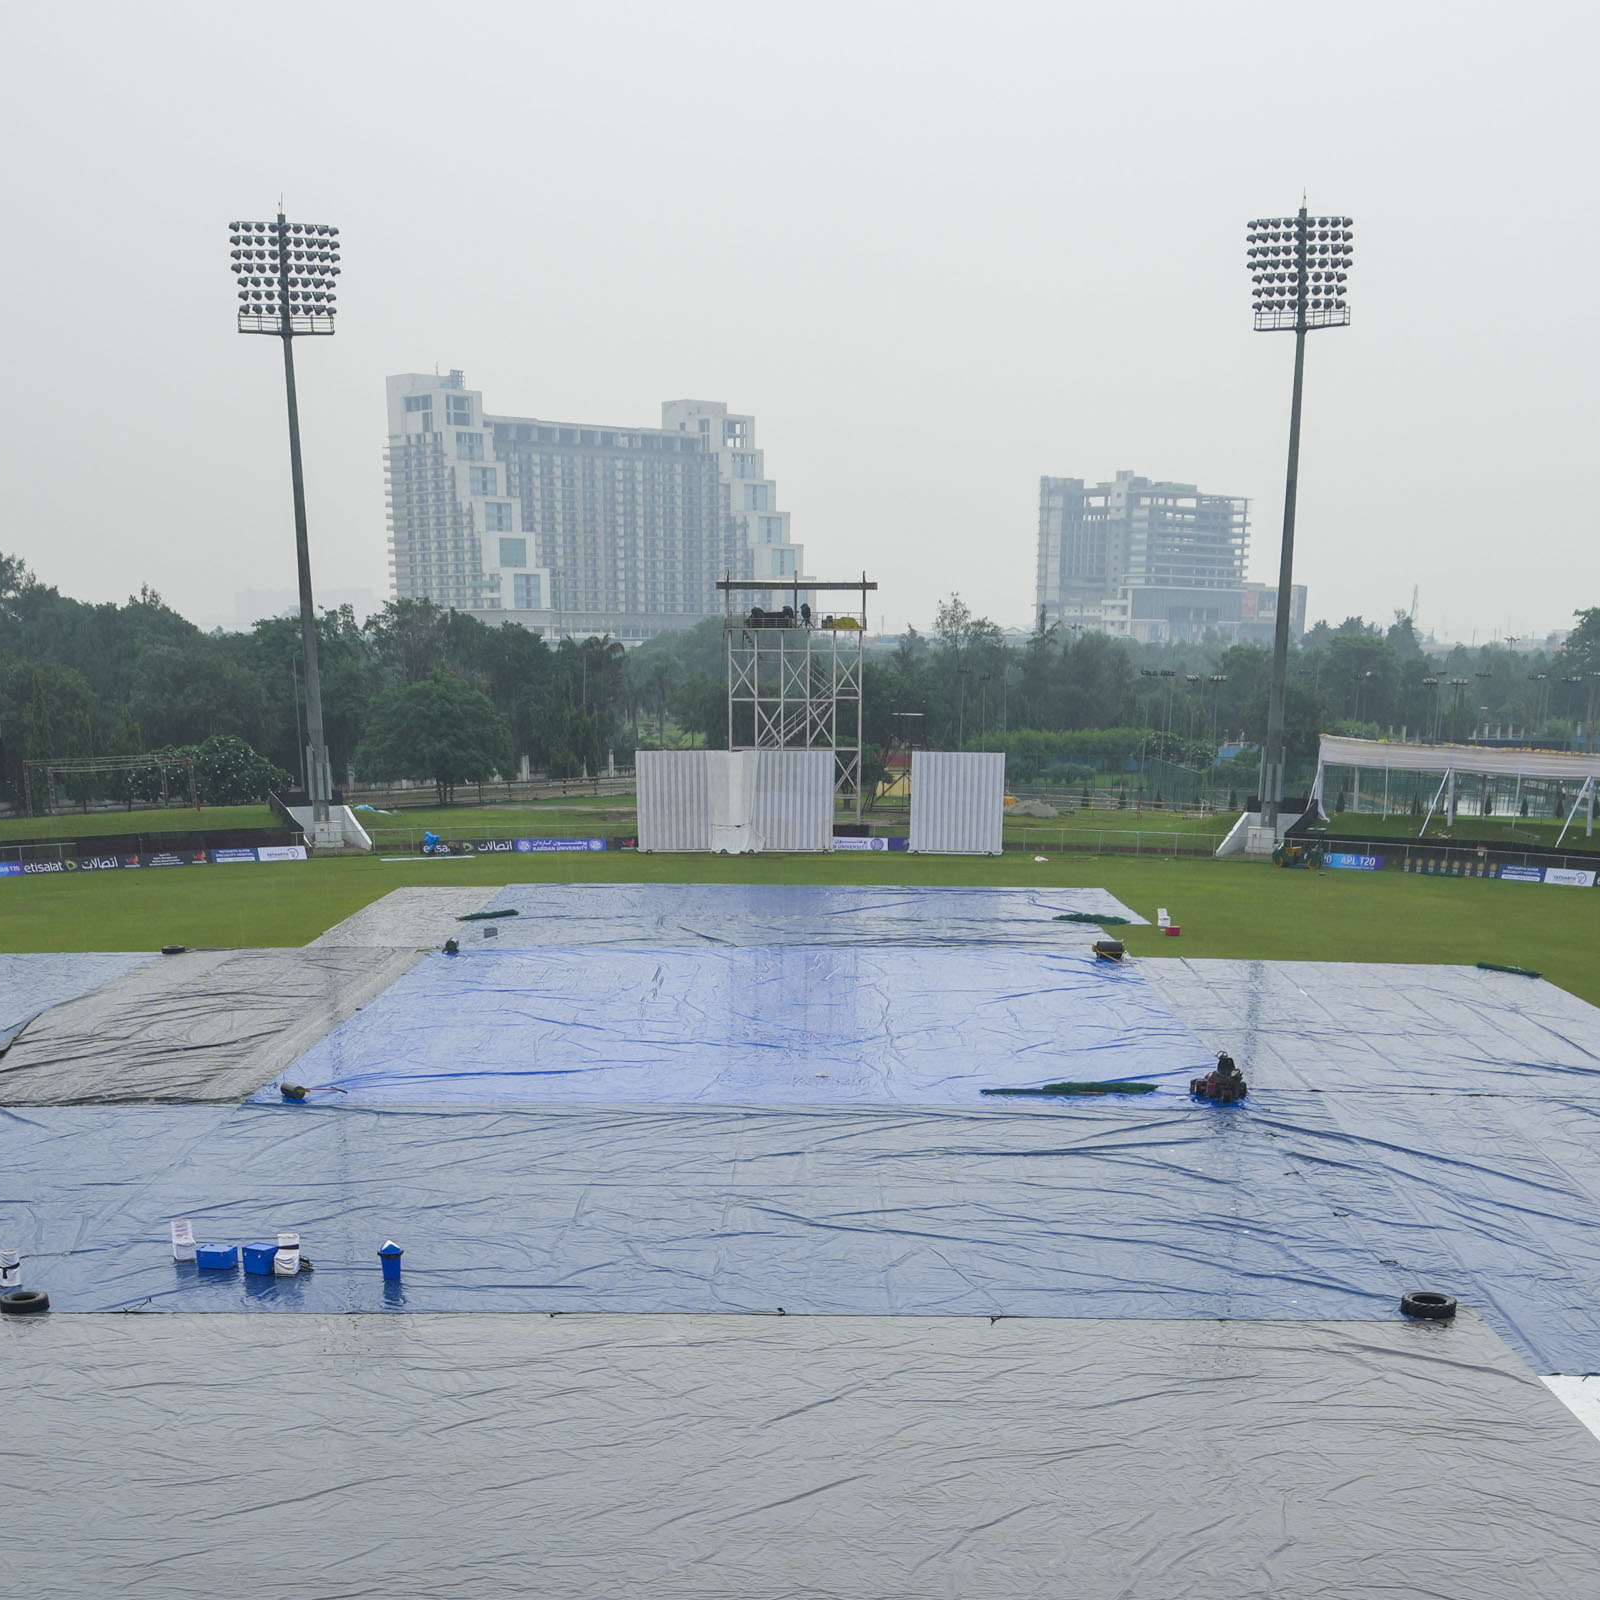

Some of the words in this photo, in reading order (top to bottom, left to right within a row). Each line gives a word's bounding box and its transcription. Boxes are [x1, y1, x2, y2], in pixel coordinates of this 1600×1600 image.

[1340, 856, 1357, 865] APL
[1360, 857, 1376, 866] T20
[24, 862, 63, 873] etisalat
